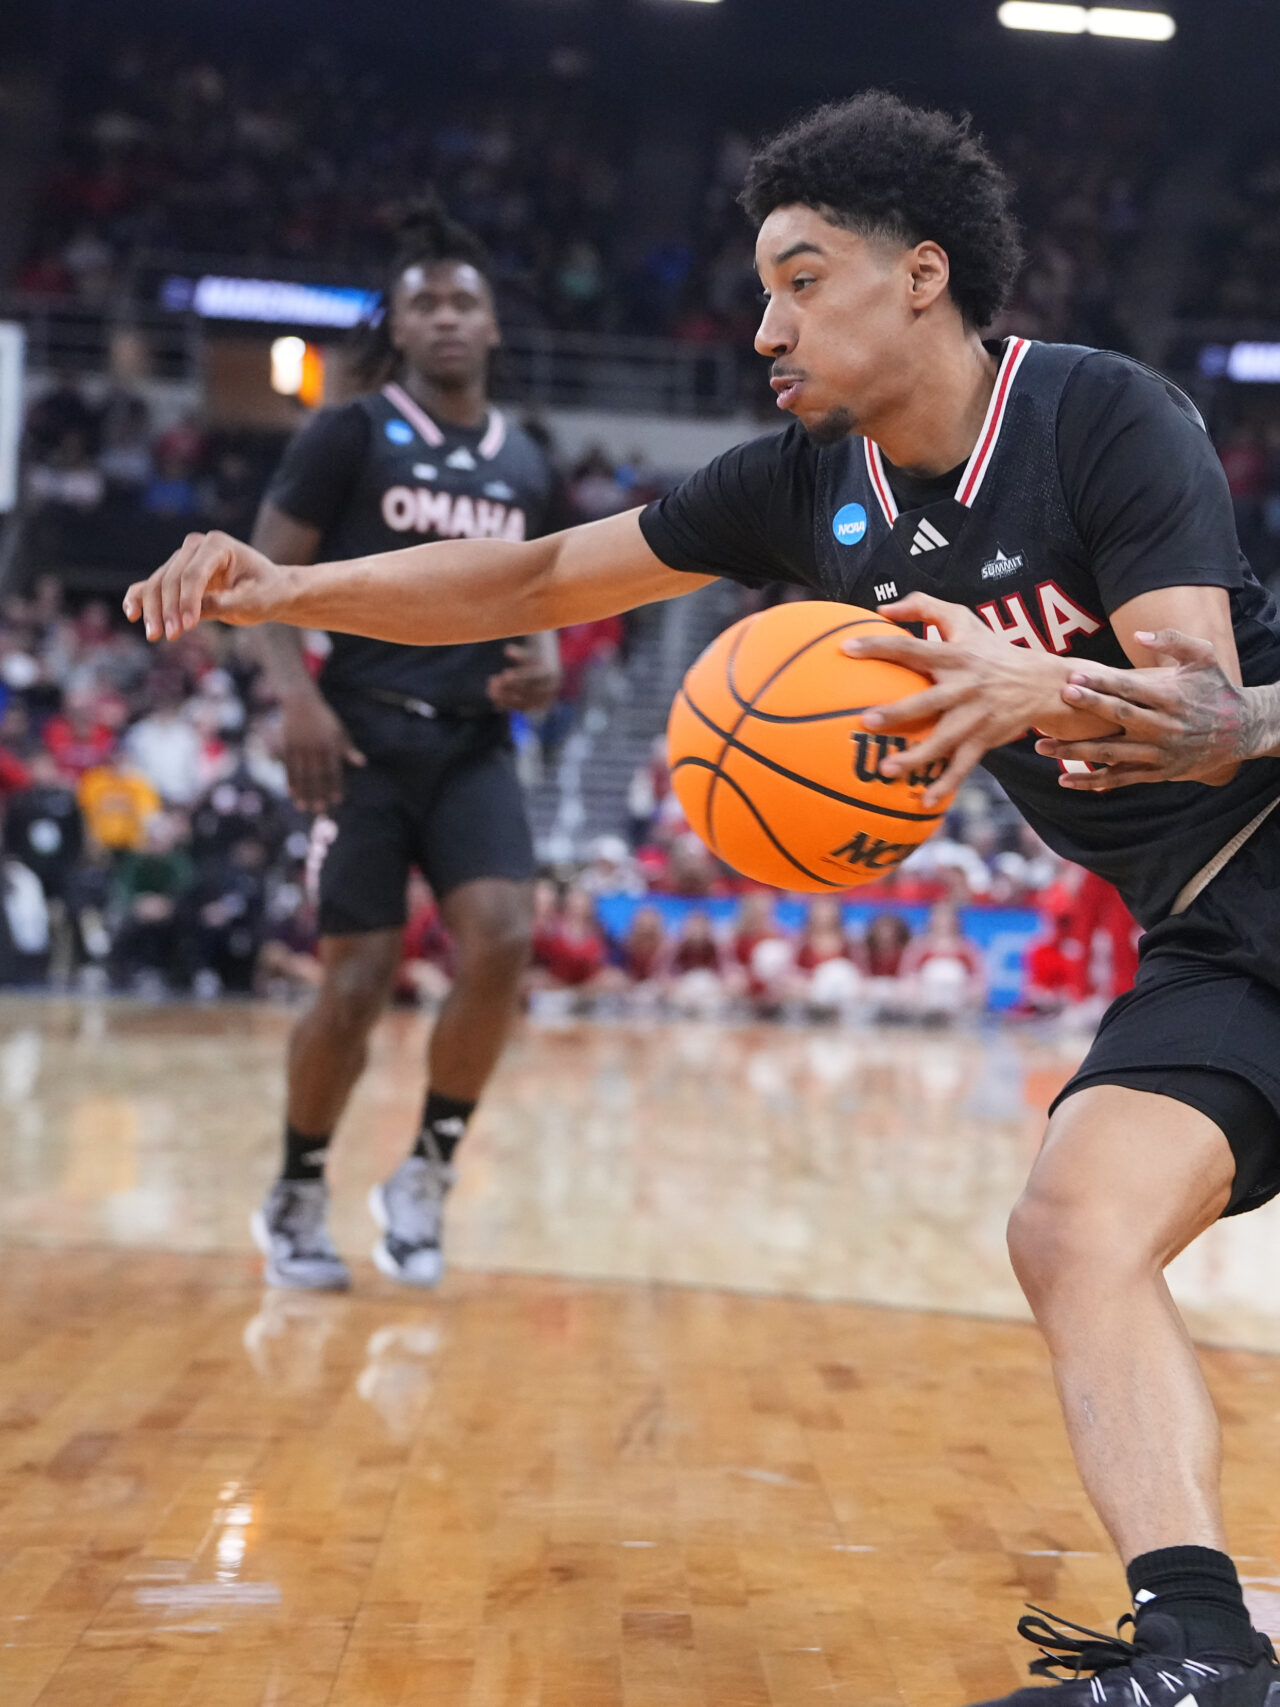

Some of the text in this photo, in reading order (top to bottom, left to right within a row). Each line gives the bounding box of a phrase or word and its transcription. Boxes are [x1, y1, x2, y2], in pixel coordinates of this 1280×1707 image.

[381, 485, 526, 542] OMAHA
[838, 520, 865, 536] NCAA
[981, 555, 1023, 580] SUMMIT
[874, 581, 898, 601] HH
